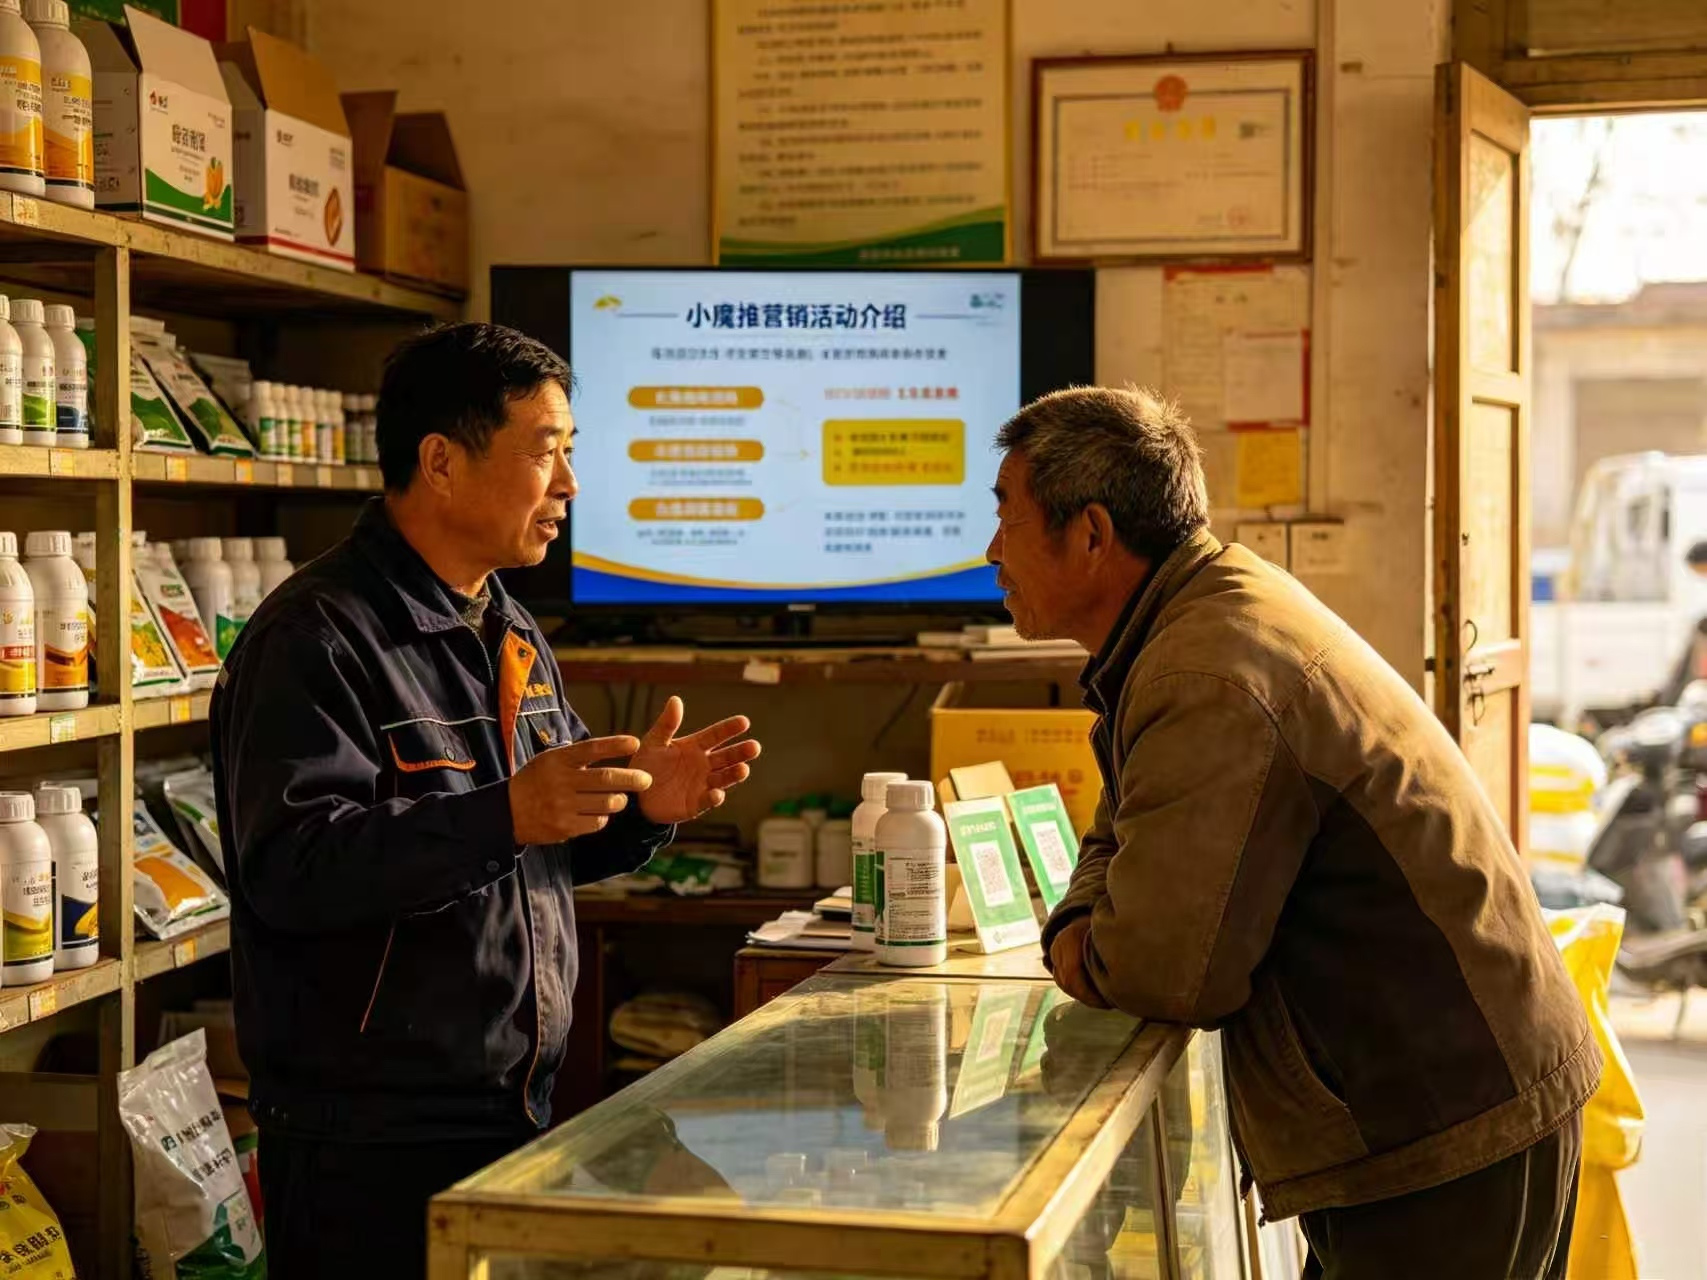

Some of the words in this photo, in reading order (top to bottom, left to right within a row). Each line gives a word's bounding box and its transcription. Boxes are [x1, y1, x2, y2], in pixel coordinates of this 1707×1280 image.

[686, 302, 906, 329] 小魔推营销活动介绍
